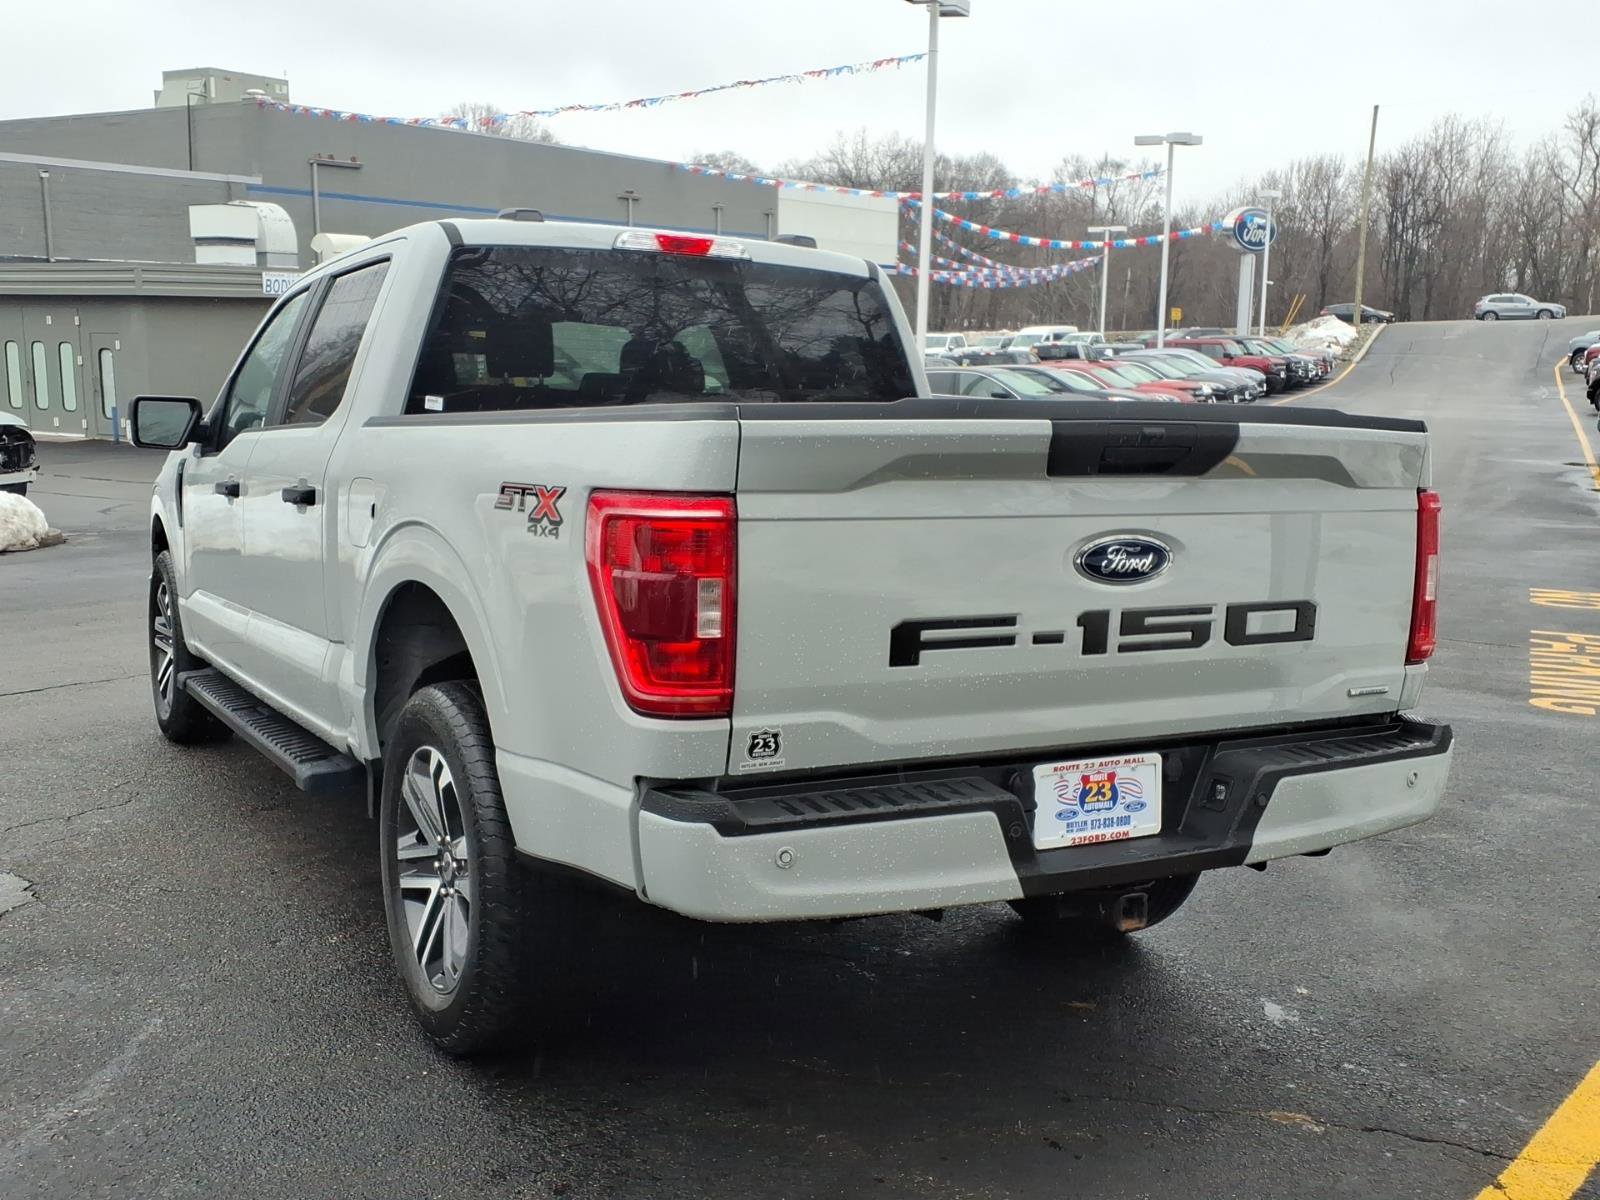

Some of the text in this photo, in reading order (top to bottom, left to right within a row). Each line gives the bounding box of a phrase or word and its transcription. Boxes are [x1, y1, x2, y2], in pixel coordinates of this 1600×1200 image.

[494, 481, 567, 526] STX
[1101, 545, 1154, 574] Ford
[889, 600, 1318, 667] F-150
[753, 738, 776, 752] 23
[1053, 764, 1080, 773] ROUTE
[1099, 760, 1121, 768] AUTO
[1124, 757, 1145, 765] MALL
[1085, 781, 1112, 802] 23
[1070, 831, 1130, 845] 23FORD.COM
